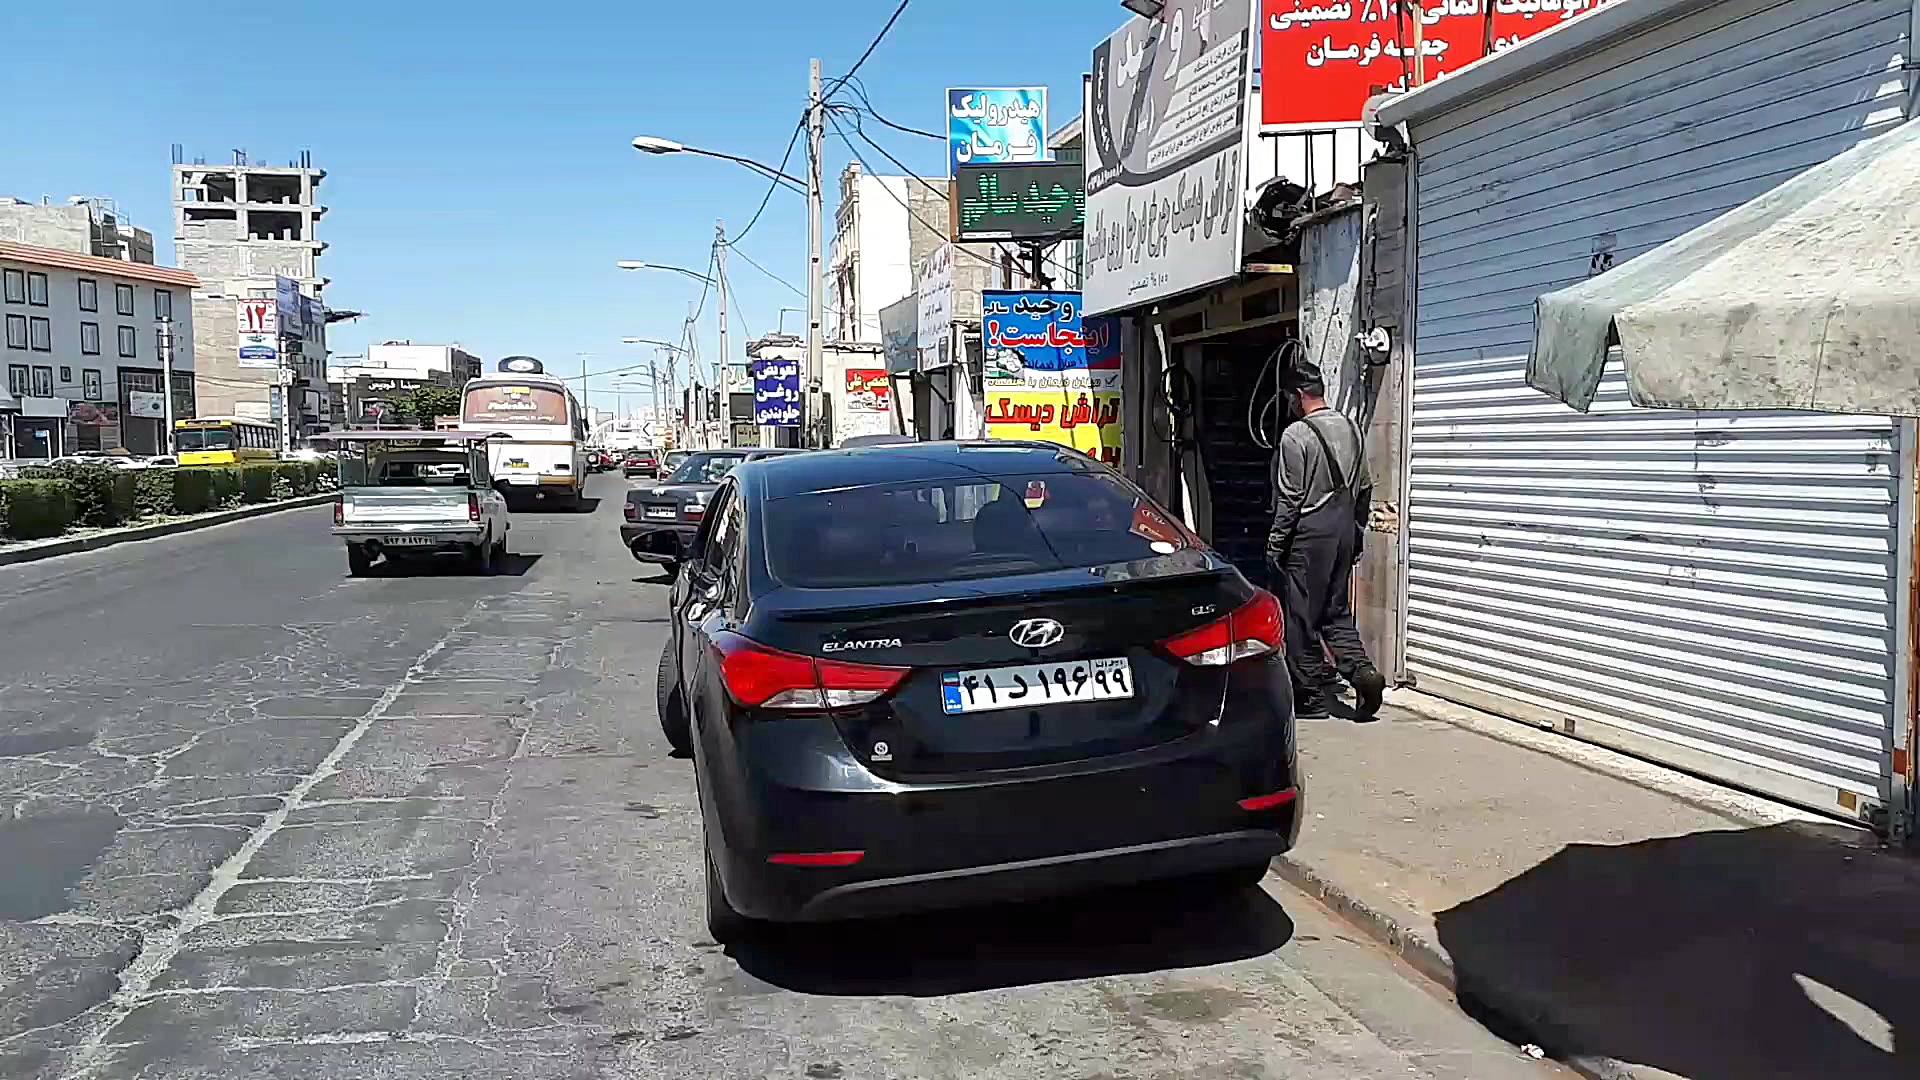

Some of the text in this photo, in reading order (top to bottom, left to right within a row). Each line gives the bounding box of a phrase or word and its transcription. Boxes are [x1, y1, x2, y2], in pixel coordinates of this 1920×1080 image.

[1306, 33, 1382, 67] فرمان
[951, 93, 1041, 126] هیدرولیک
[956, 129, 1038, 162] فرمان
[1013, 295, 1074, 322] وحید
[987, 321, 1110, 355] اینجاست!
[756, 361, 797, 381] تعویض
[756, 382, 799, 402] روغن
[756, 403, 800, 424] جلوبندی
[985, 398, 1055, 431] دیسک
[1191, 603, 1217, 617] GLS
[822, 637, 903, 653] ELANTRA
[1095, 668, 1129, 694] ۹۹
